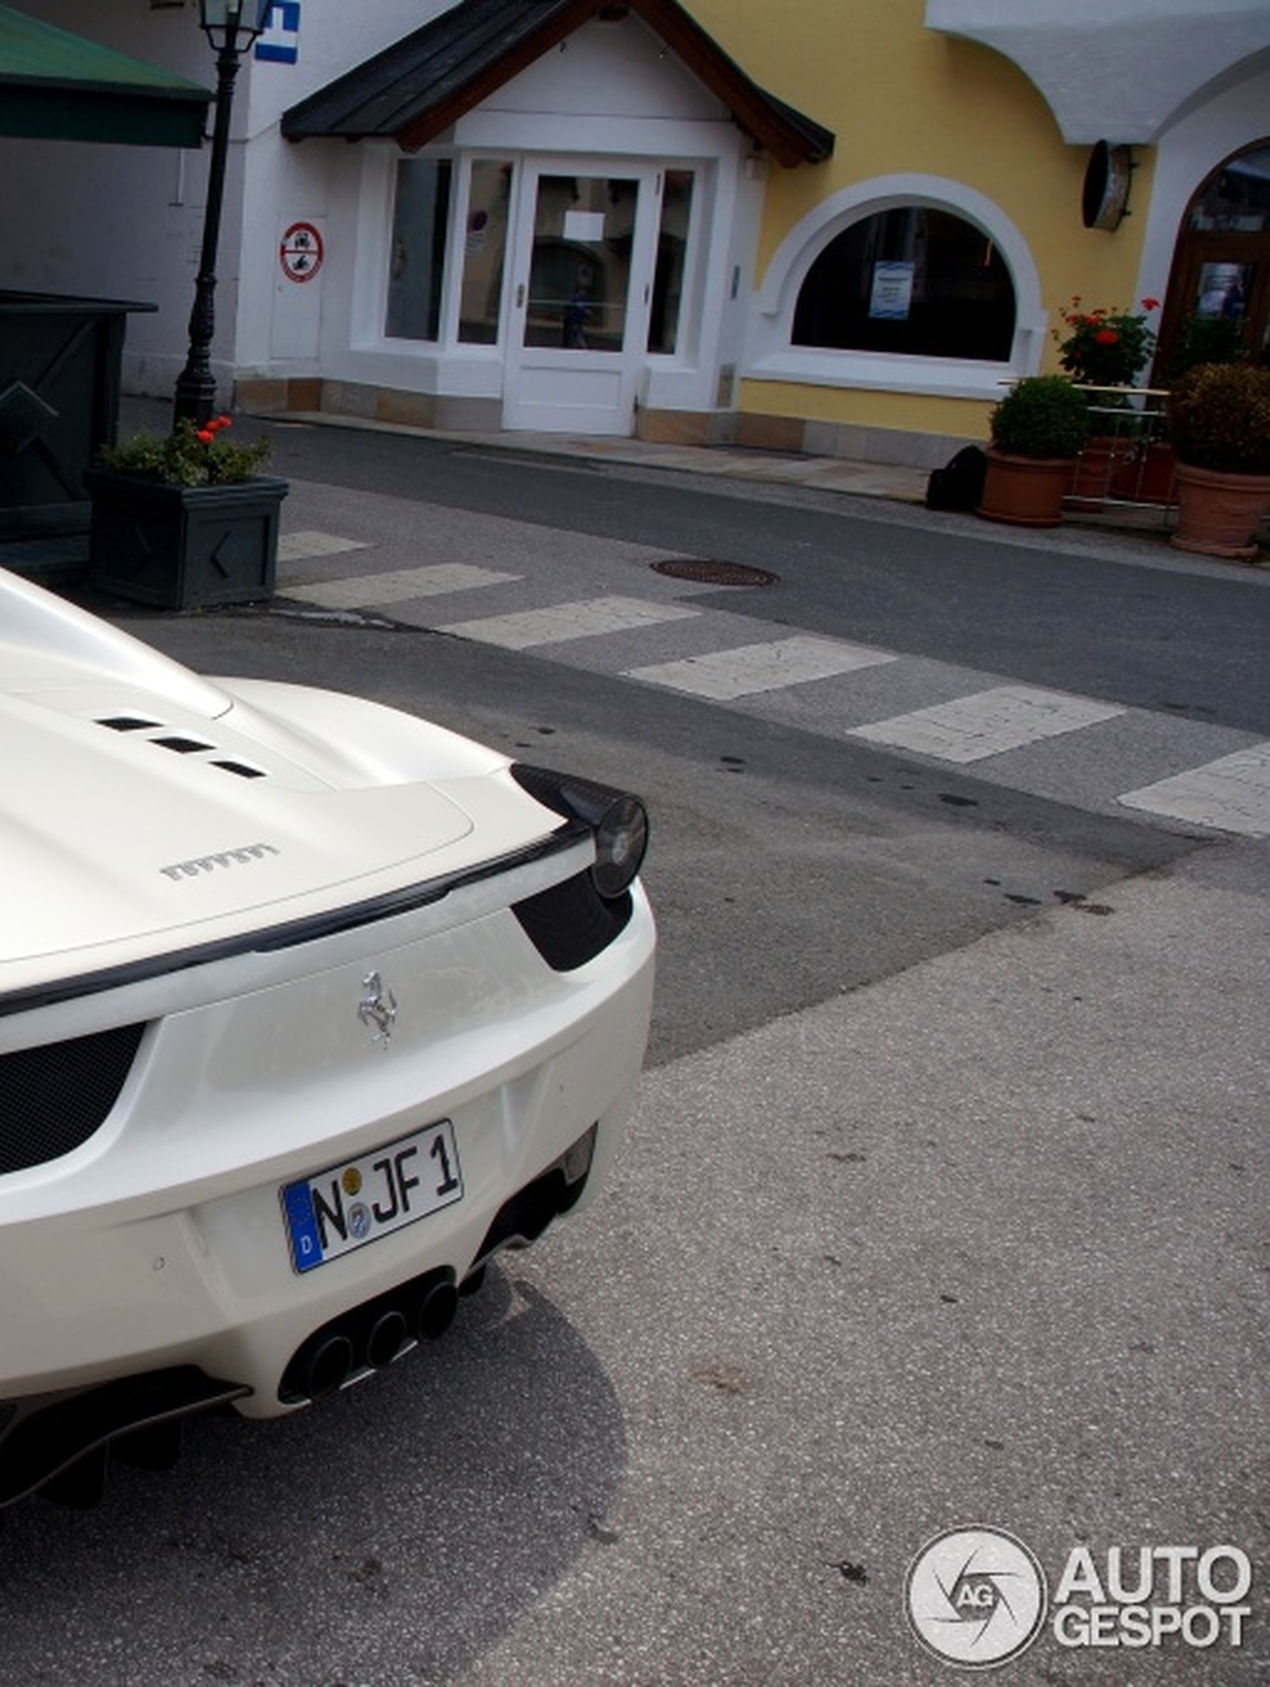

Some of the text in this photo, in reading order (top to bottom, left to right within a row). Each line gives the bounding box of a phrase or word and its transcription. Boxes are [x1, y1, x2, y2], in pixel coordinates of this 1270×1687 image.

[313, 1135, 458, 1248] N JF 1
[300, 1235, 313, 1254] D
